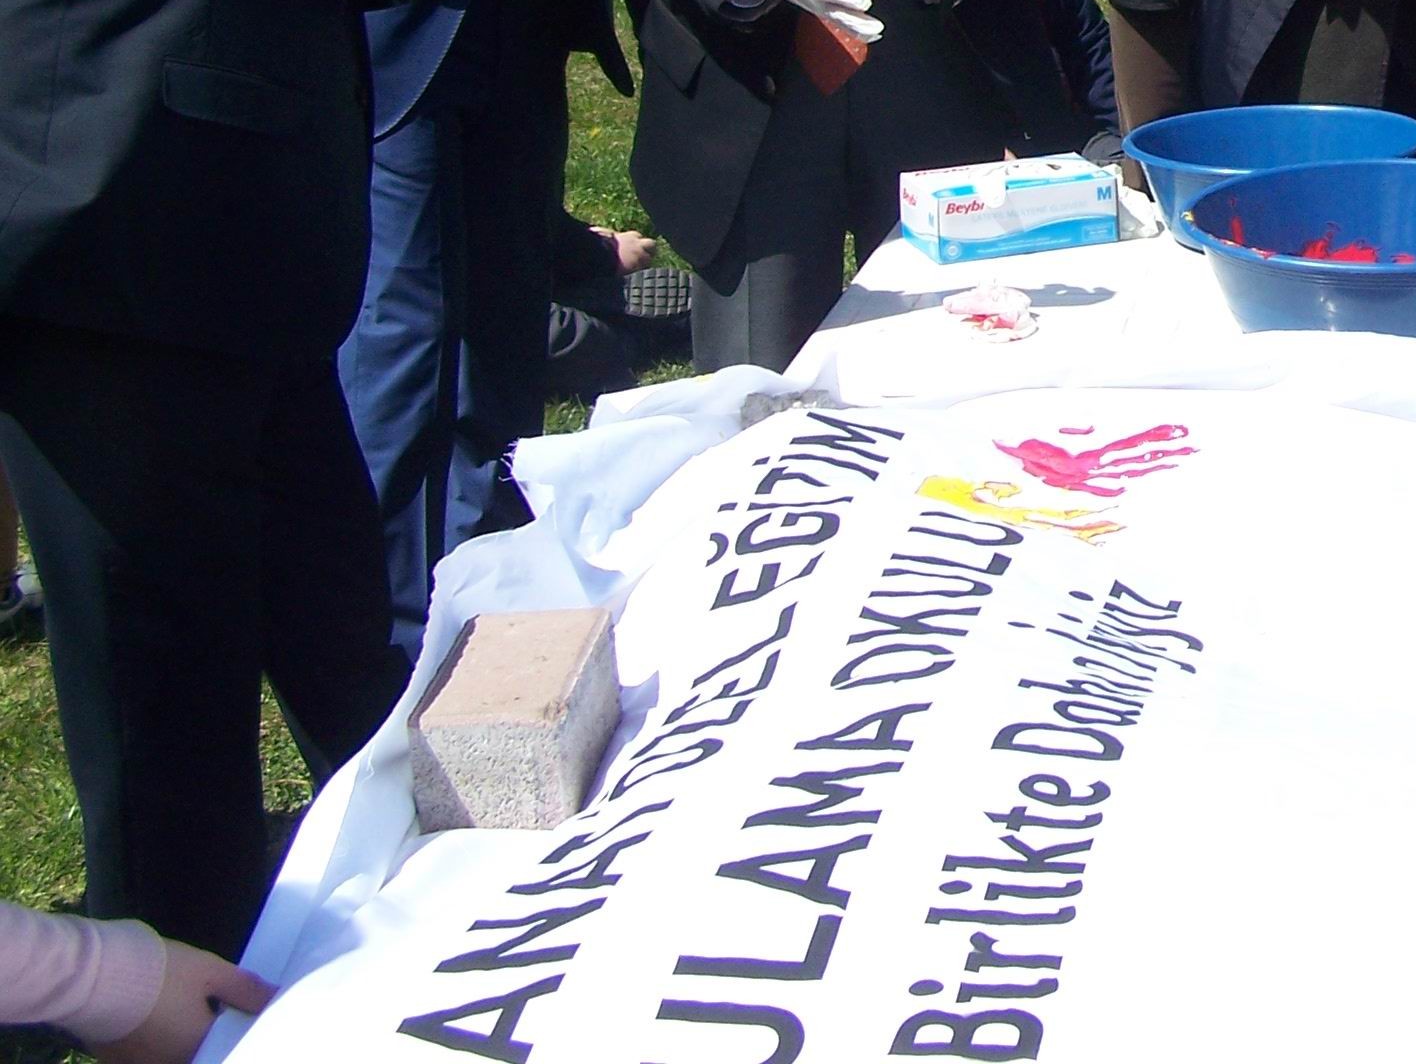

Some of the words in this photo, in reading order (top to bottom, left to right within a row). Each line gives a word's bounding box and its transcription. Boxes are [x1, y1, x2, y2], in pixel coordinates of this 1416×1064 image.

[1096, 185, 1113, 201] M
[705, 411, 905, 611] EĞİTİM
[830, 511, 1024, 691] OKULU
[990, 655, 1154, 762] Daha
[887, 773, 1112, 1063] Birlikte
